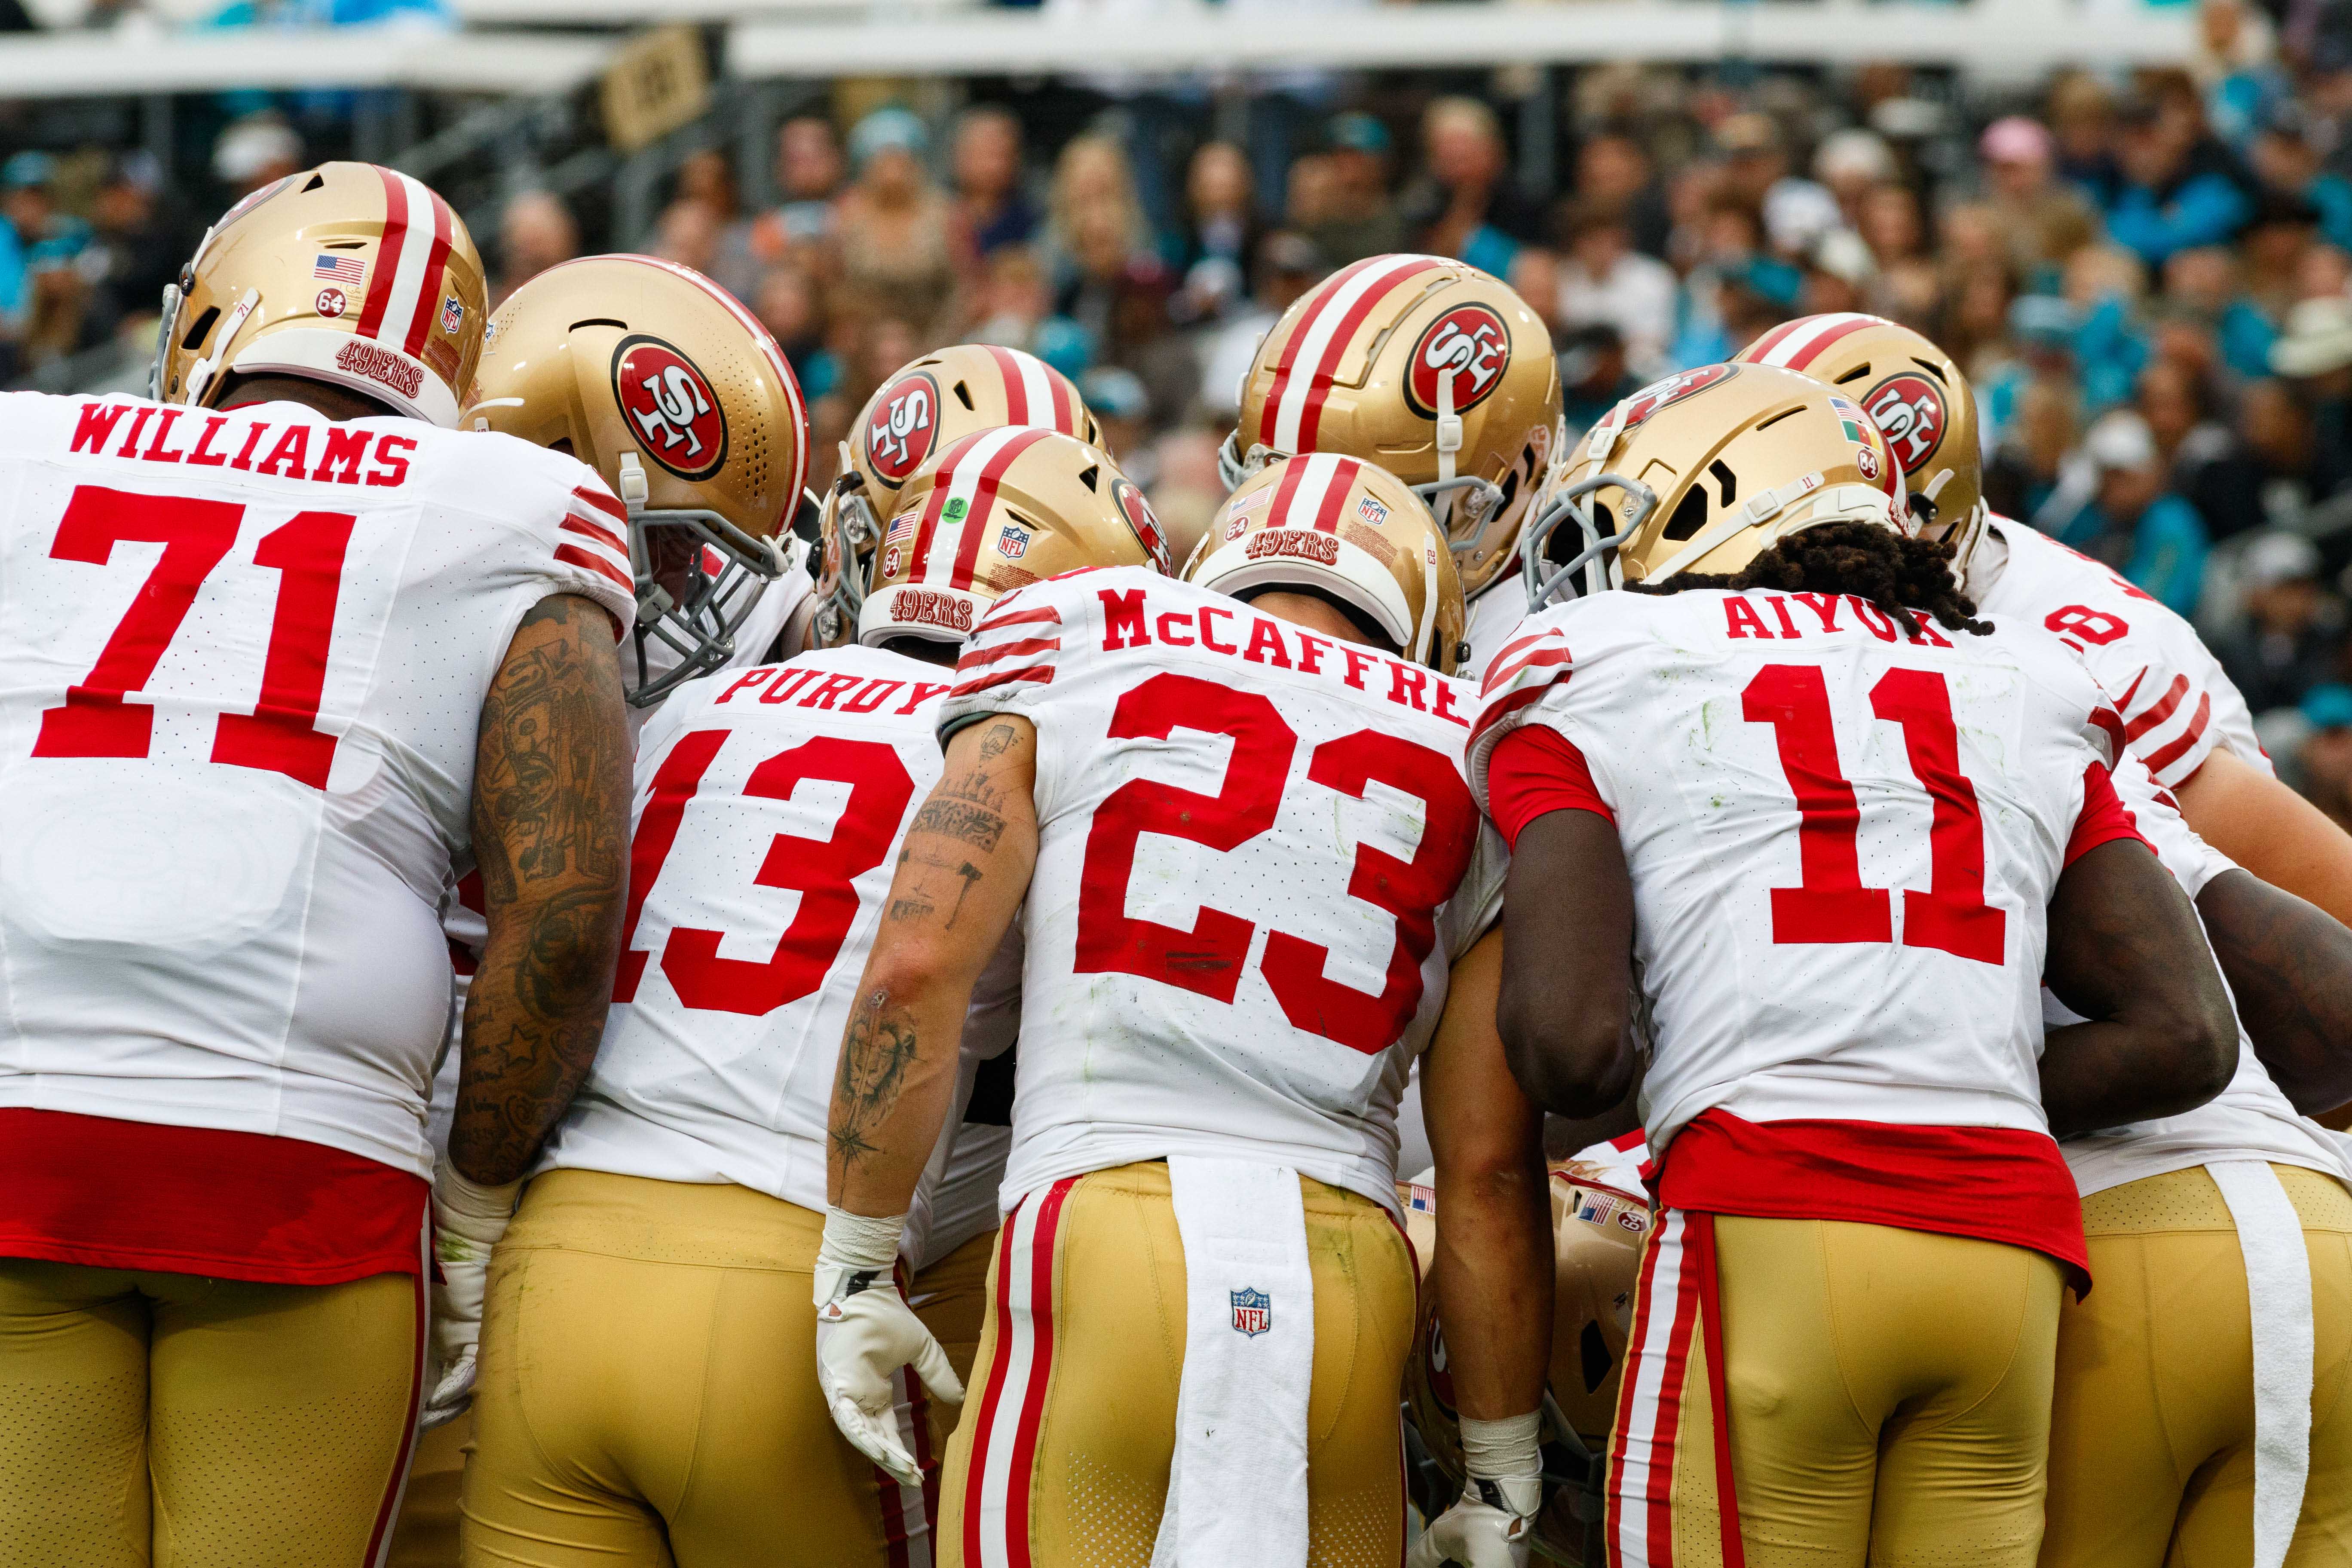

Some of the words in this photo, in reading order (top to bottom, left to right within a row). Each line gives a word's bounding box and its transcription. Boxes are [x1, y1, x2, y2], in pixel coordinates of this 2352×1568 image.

[237, 303, 249, 318] 71
[318, 292, 344, 313] 64
[443, 310, 458, 330] NFL
[336, 340, 424, 399] 49ERS
[70, 403, 418, 487] WILLIAMS
[1802, 476, 1815, 490] 11
[1360, 506, 1382, 523] NFL
[1227, 518, 1246, 540] 64
[1000, 537, 1022, 555] NFL
[1245, 530, 1338, 566] 49ERS
[1427, 549, 1436, 565] 23
[885, 552, 898, 573] 64
[1008, 564, 1035, 576] WARNING
[890, 589, 973, 632] 49ERS
[31, 484, 357, 791] 71
[2044, 605, 2130, 653] 8
[1097, 588, 1472, 729] McCAFFRE
[715, 668, 952, 715] PURDY
[1741, 664, 2006, 966] 11
[610, 729, 916, 1017] 13
[1073, 671, 1481, 1055] 23
[1621, 1212, 1644, 1231] 64
[1235, 1308, 1267, 1332] NFL
